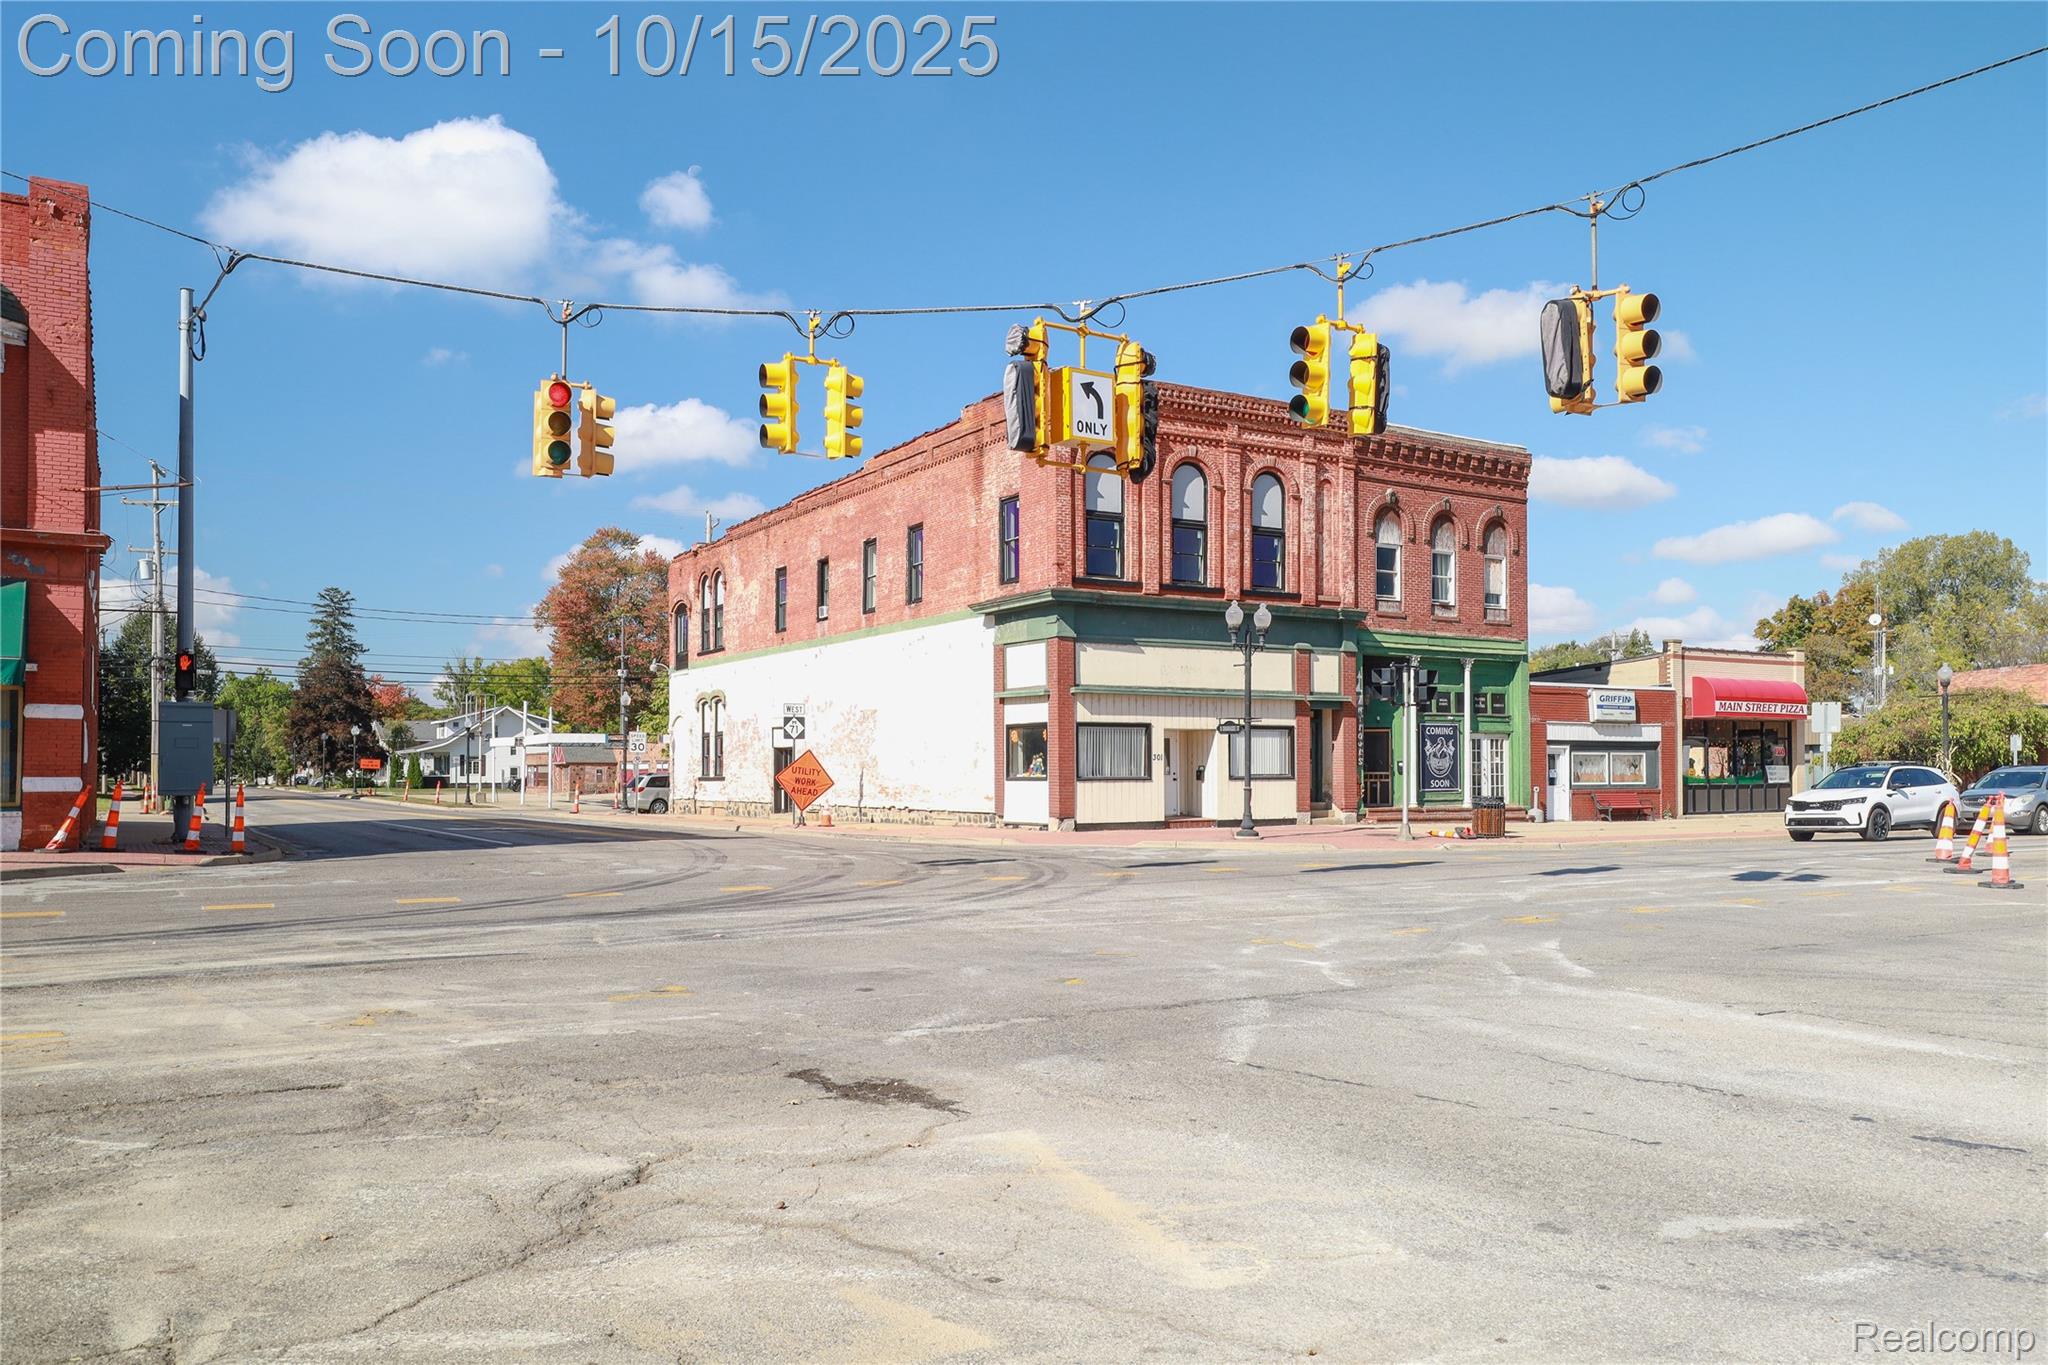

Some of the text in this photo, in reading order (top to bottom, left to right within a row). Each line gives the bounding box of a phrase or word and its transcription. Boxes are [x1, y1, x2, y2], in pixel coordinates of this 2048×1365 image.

[1077, 420, 1108, 436] ONLY
[1599, 695, 1631, 703] GRIFFIN
[1719, 702, 1804, 713] MAIN STREET PIZZA
[789, 725, 798, 734] 71
[1426, 727, 1453, 735] COMING
[631, 743, 645, 751] 30
[791, 767, 821, 776] UTILITY
[795, 777, 816, 786] WORK
[791, 787, 818, 796] AHEAD
